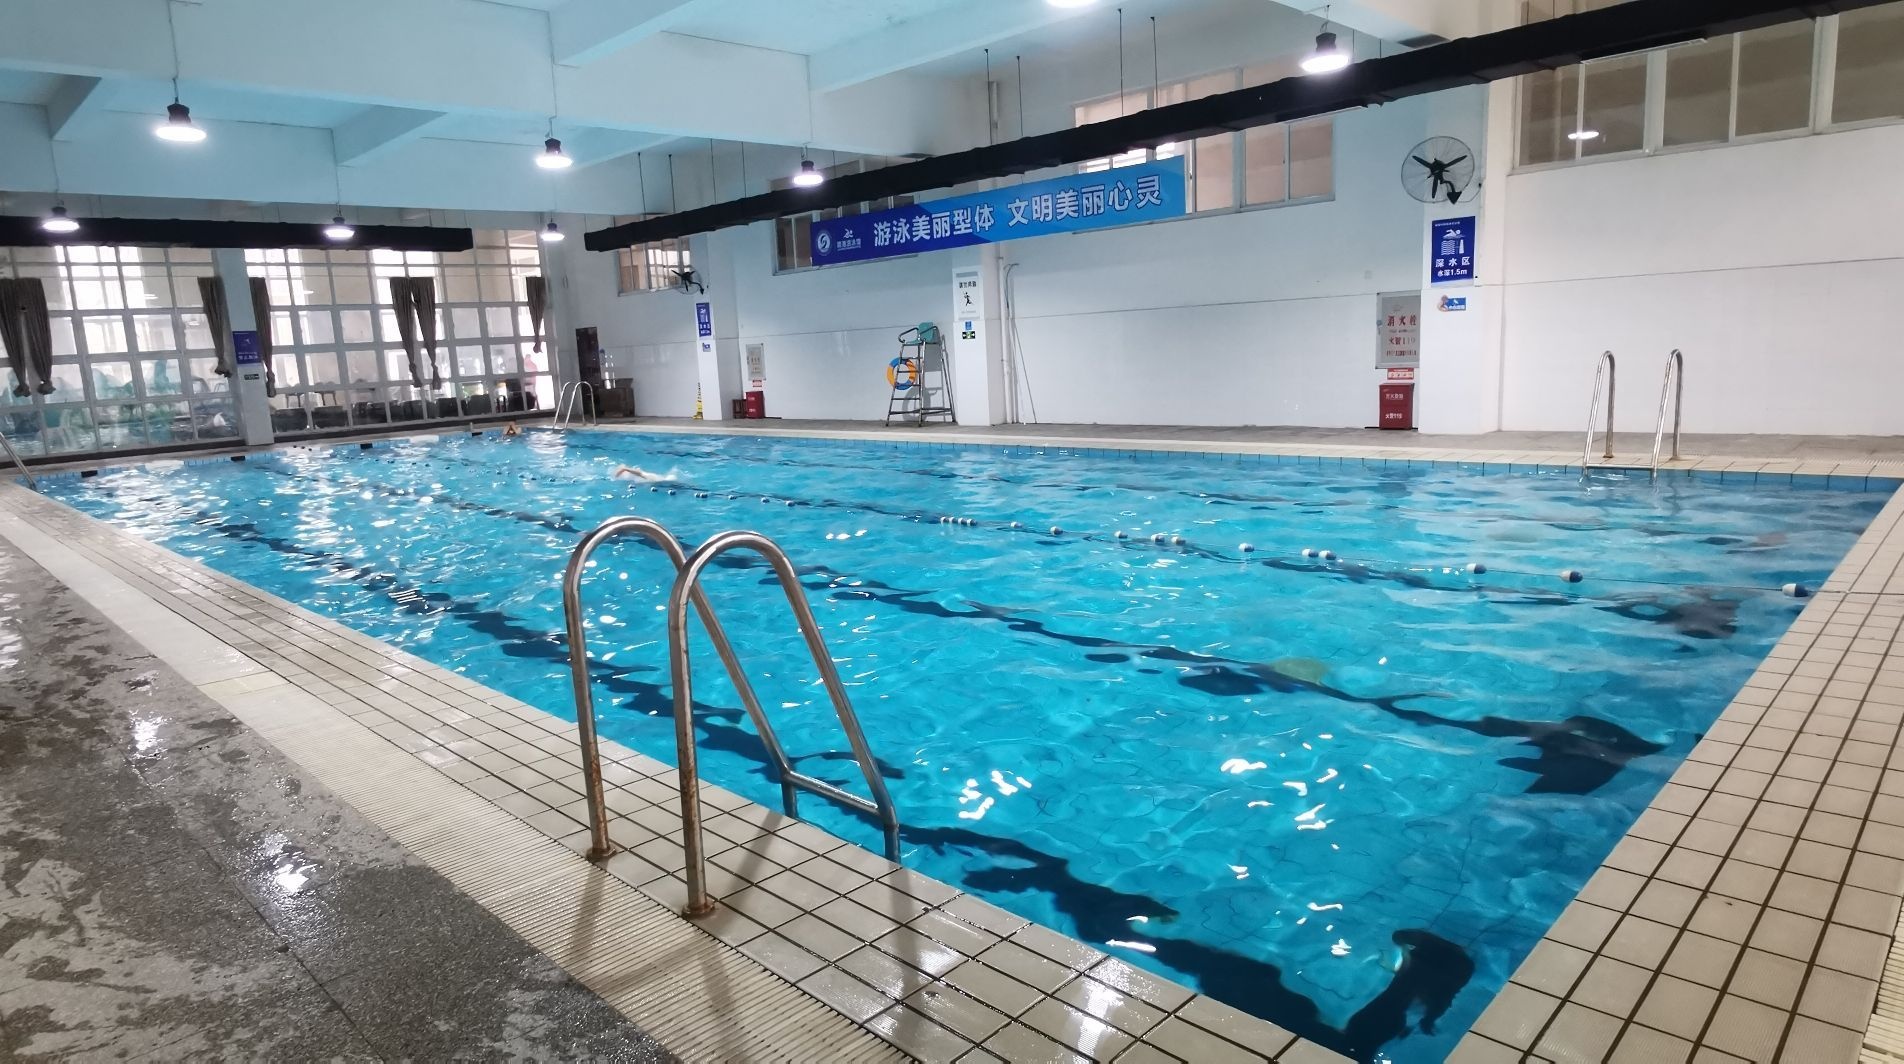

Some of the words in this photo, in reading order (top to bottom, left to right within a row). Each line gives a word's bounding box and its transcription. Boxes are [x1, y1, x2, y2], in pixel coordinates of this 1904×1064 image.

[873, 203, 995, 247] 游泳美丽型体
[1007, 175, 1162, 227] 文明美丽心灵
[1435, 256, 1470, 268] 深水区
[1437, 268, 1468, 277] 水深1.5m
[1387, 314, 1416, 327] 消火栓
